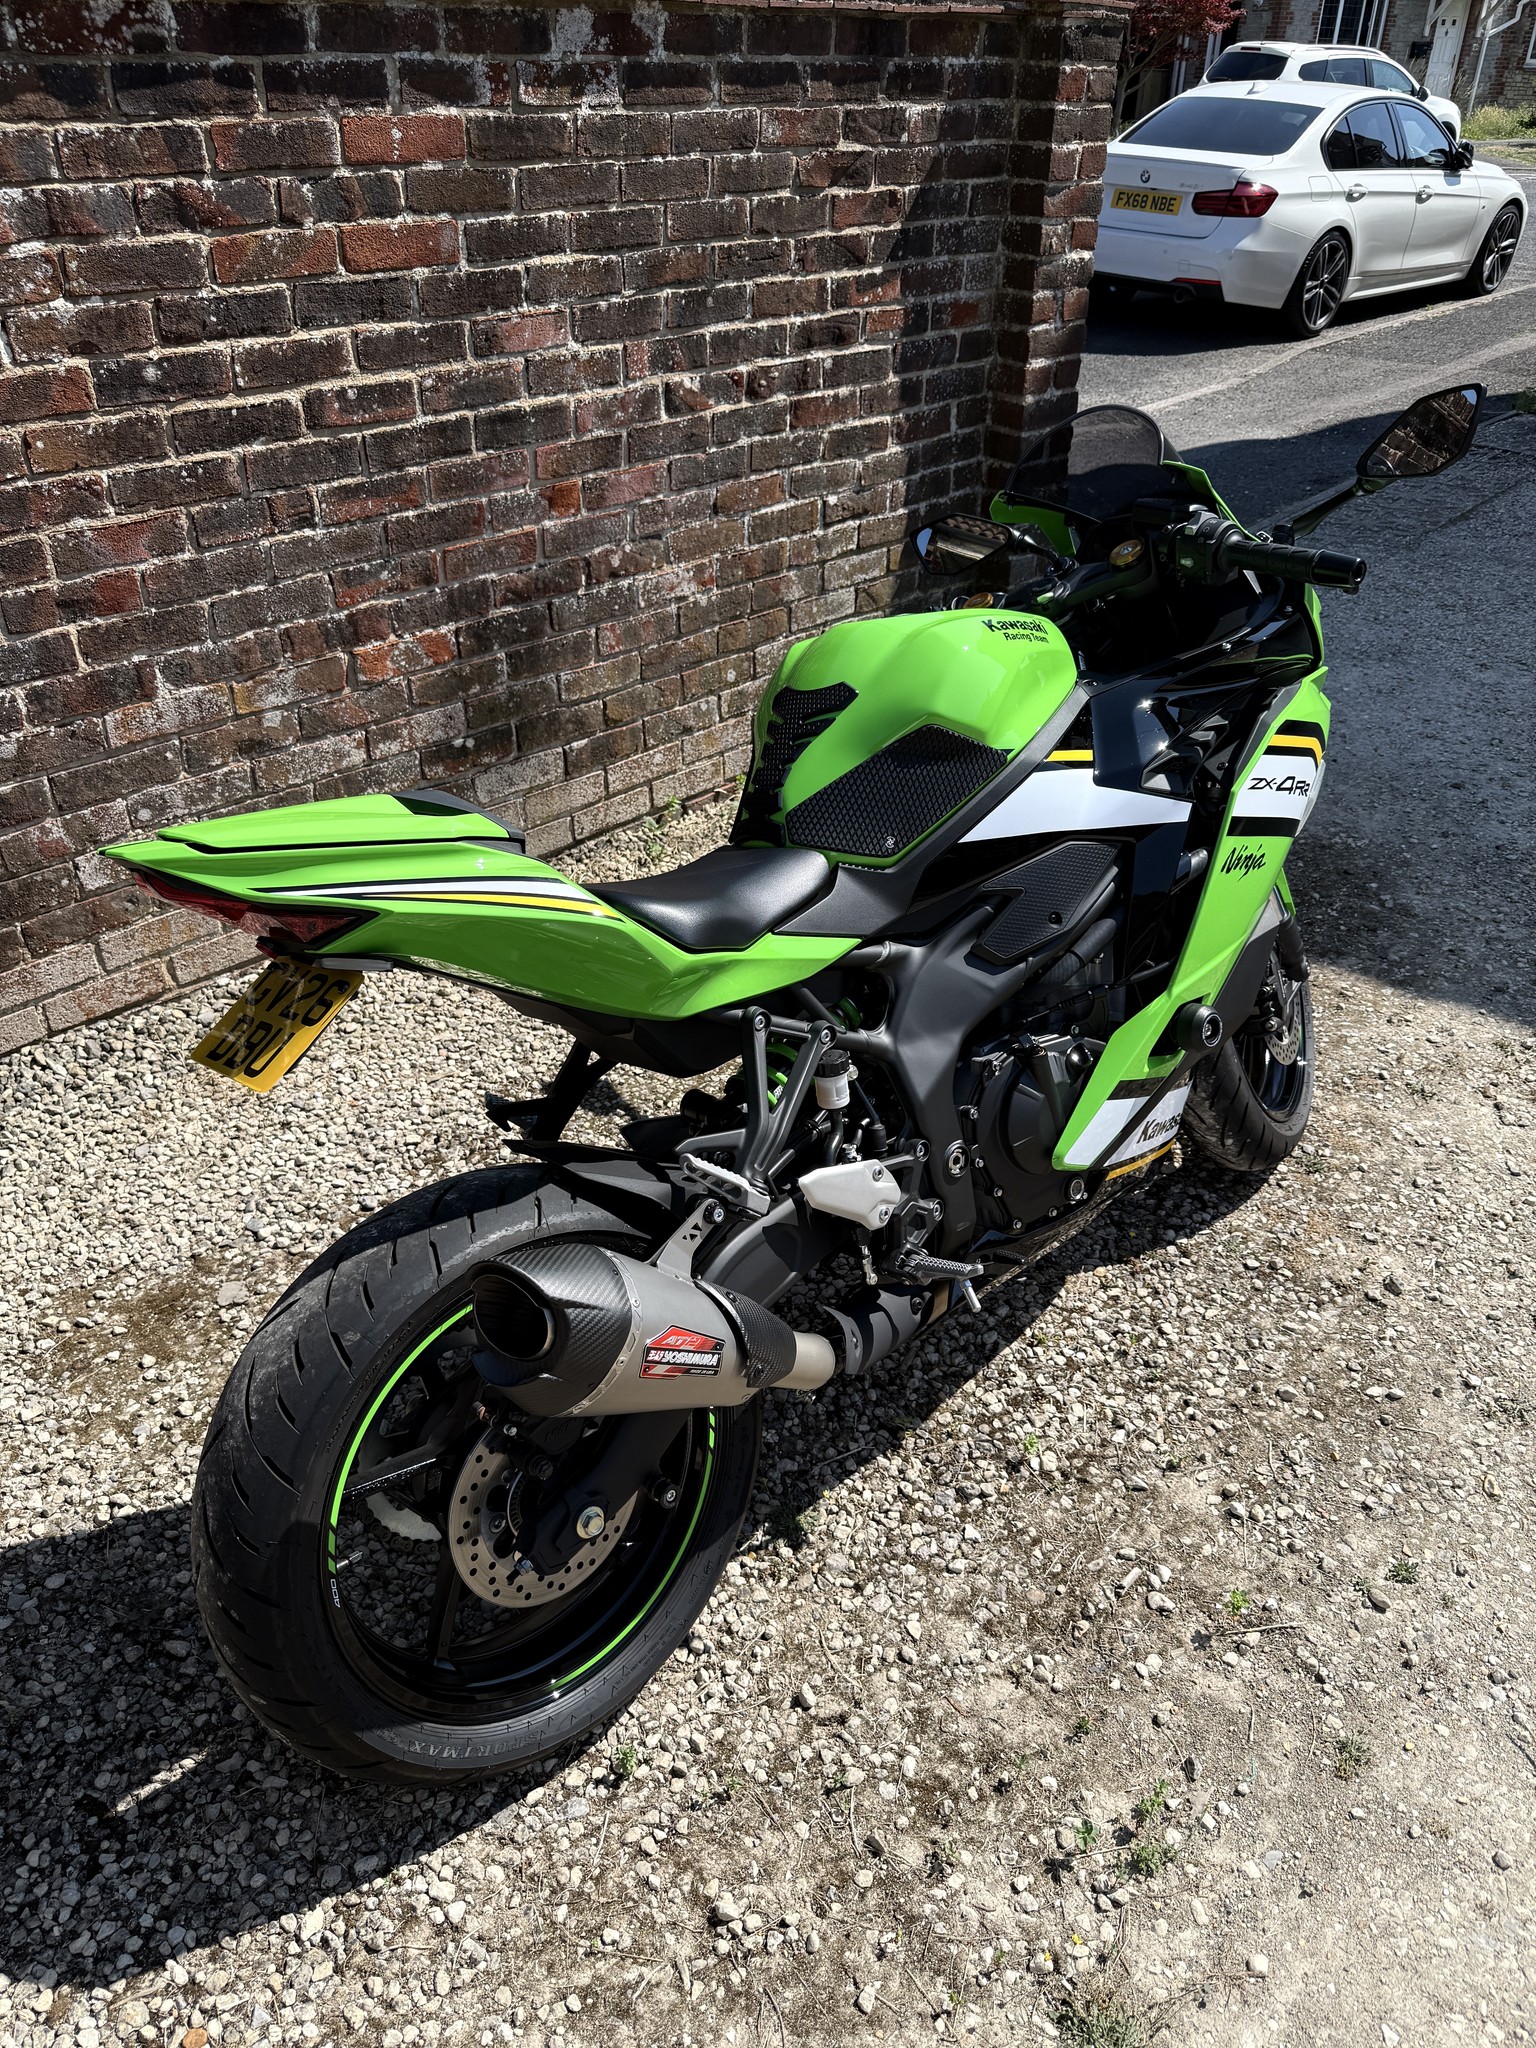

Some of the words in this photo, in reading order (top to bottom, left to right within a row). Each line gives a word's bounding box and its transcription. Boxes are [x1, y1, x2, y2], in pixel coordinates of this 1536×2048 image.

[1115, 191, 1147, 209] FX68
[1150, 195, 1177, 213] NBE
[981, 619, 1049, 635] Kawasaki
[1003, 632, 1033, 642] Racing
[1031, 633, 1049, 644] Team
[1220, 843, 1266, 881] Ninja
[661, 1350, 720, 1366] YOSHIMURA
[408, 1730, 540, 1760] SPORTMAX
